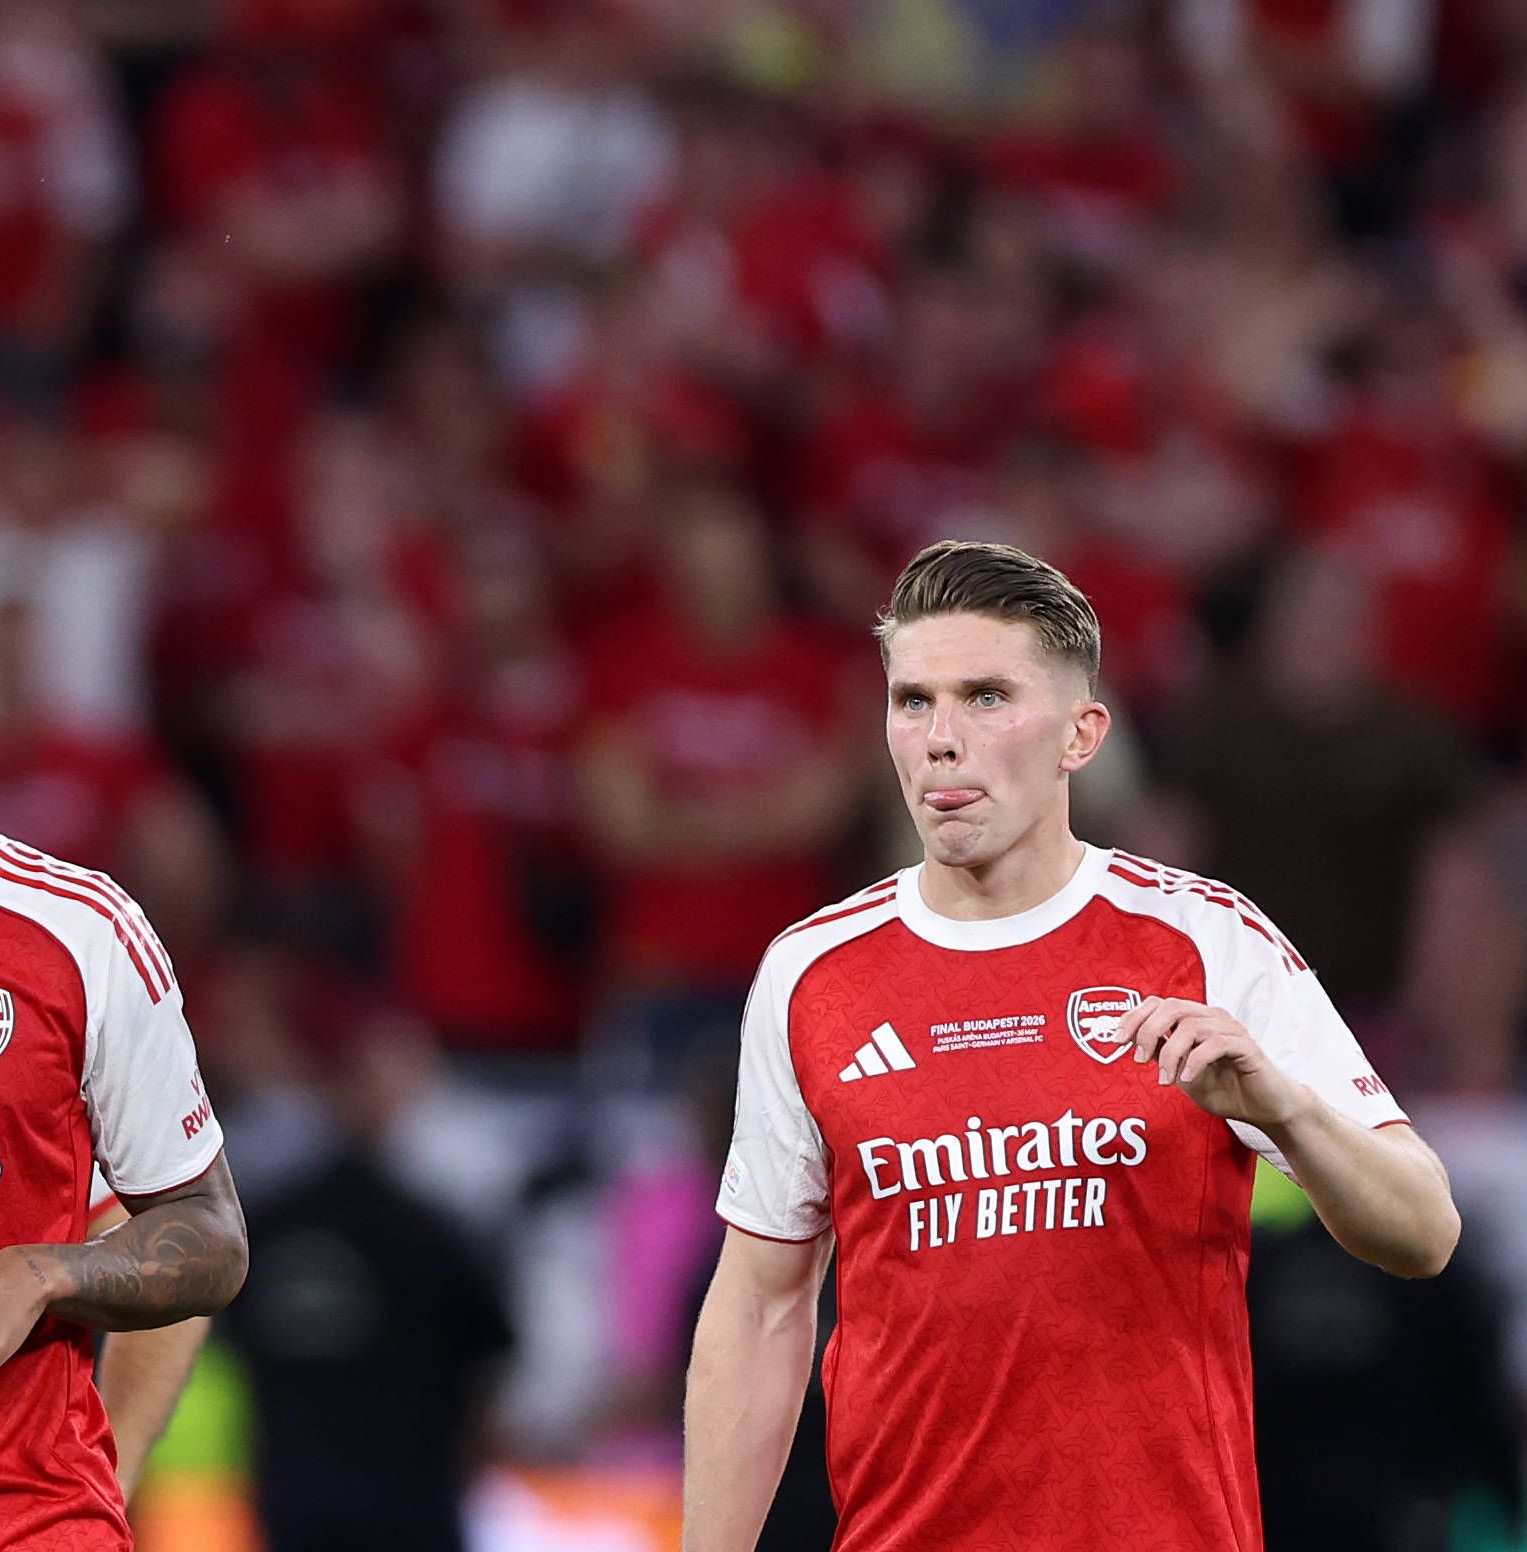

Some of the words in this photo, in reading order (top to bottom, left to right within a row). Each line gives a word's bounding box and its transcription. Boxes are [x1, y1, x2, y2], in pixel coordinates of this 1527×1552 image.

[930, 1023, 961, 1036] FINAL
[963, 1016, 1019, 1031] BUDAPEST
[1020, 1015, 1046, 1026] 2026
[1079, 999, 1132, 1012] Arsenal
[856, 1109, 1147, 1200] Emirates
[909, 1192, 963, 1251] FLY
[977, 1178, 1106, 1239] BETTER
